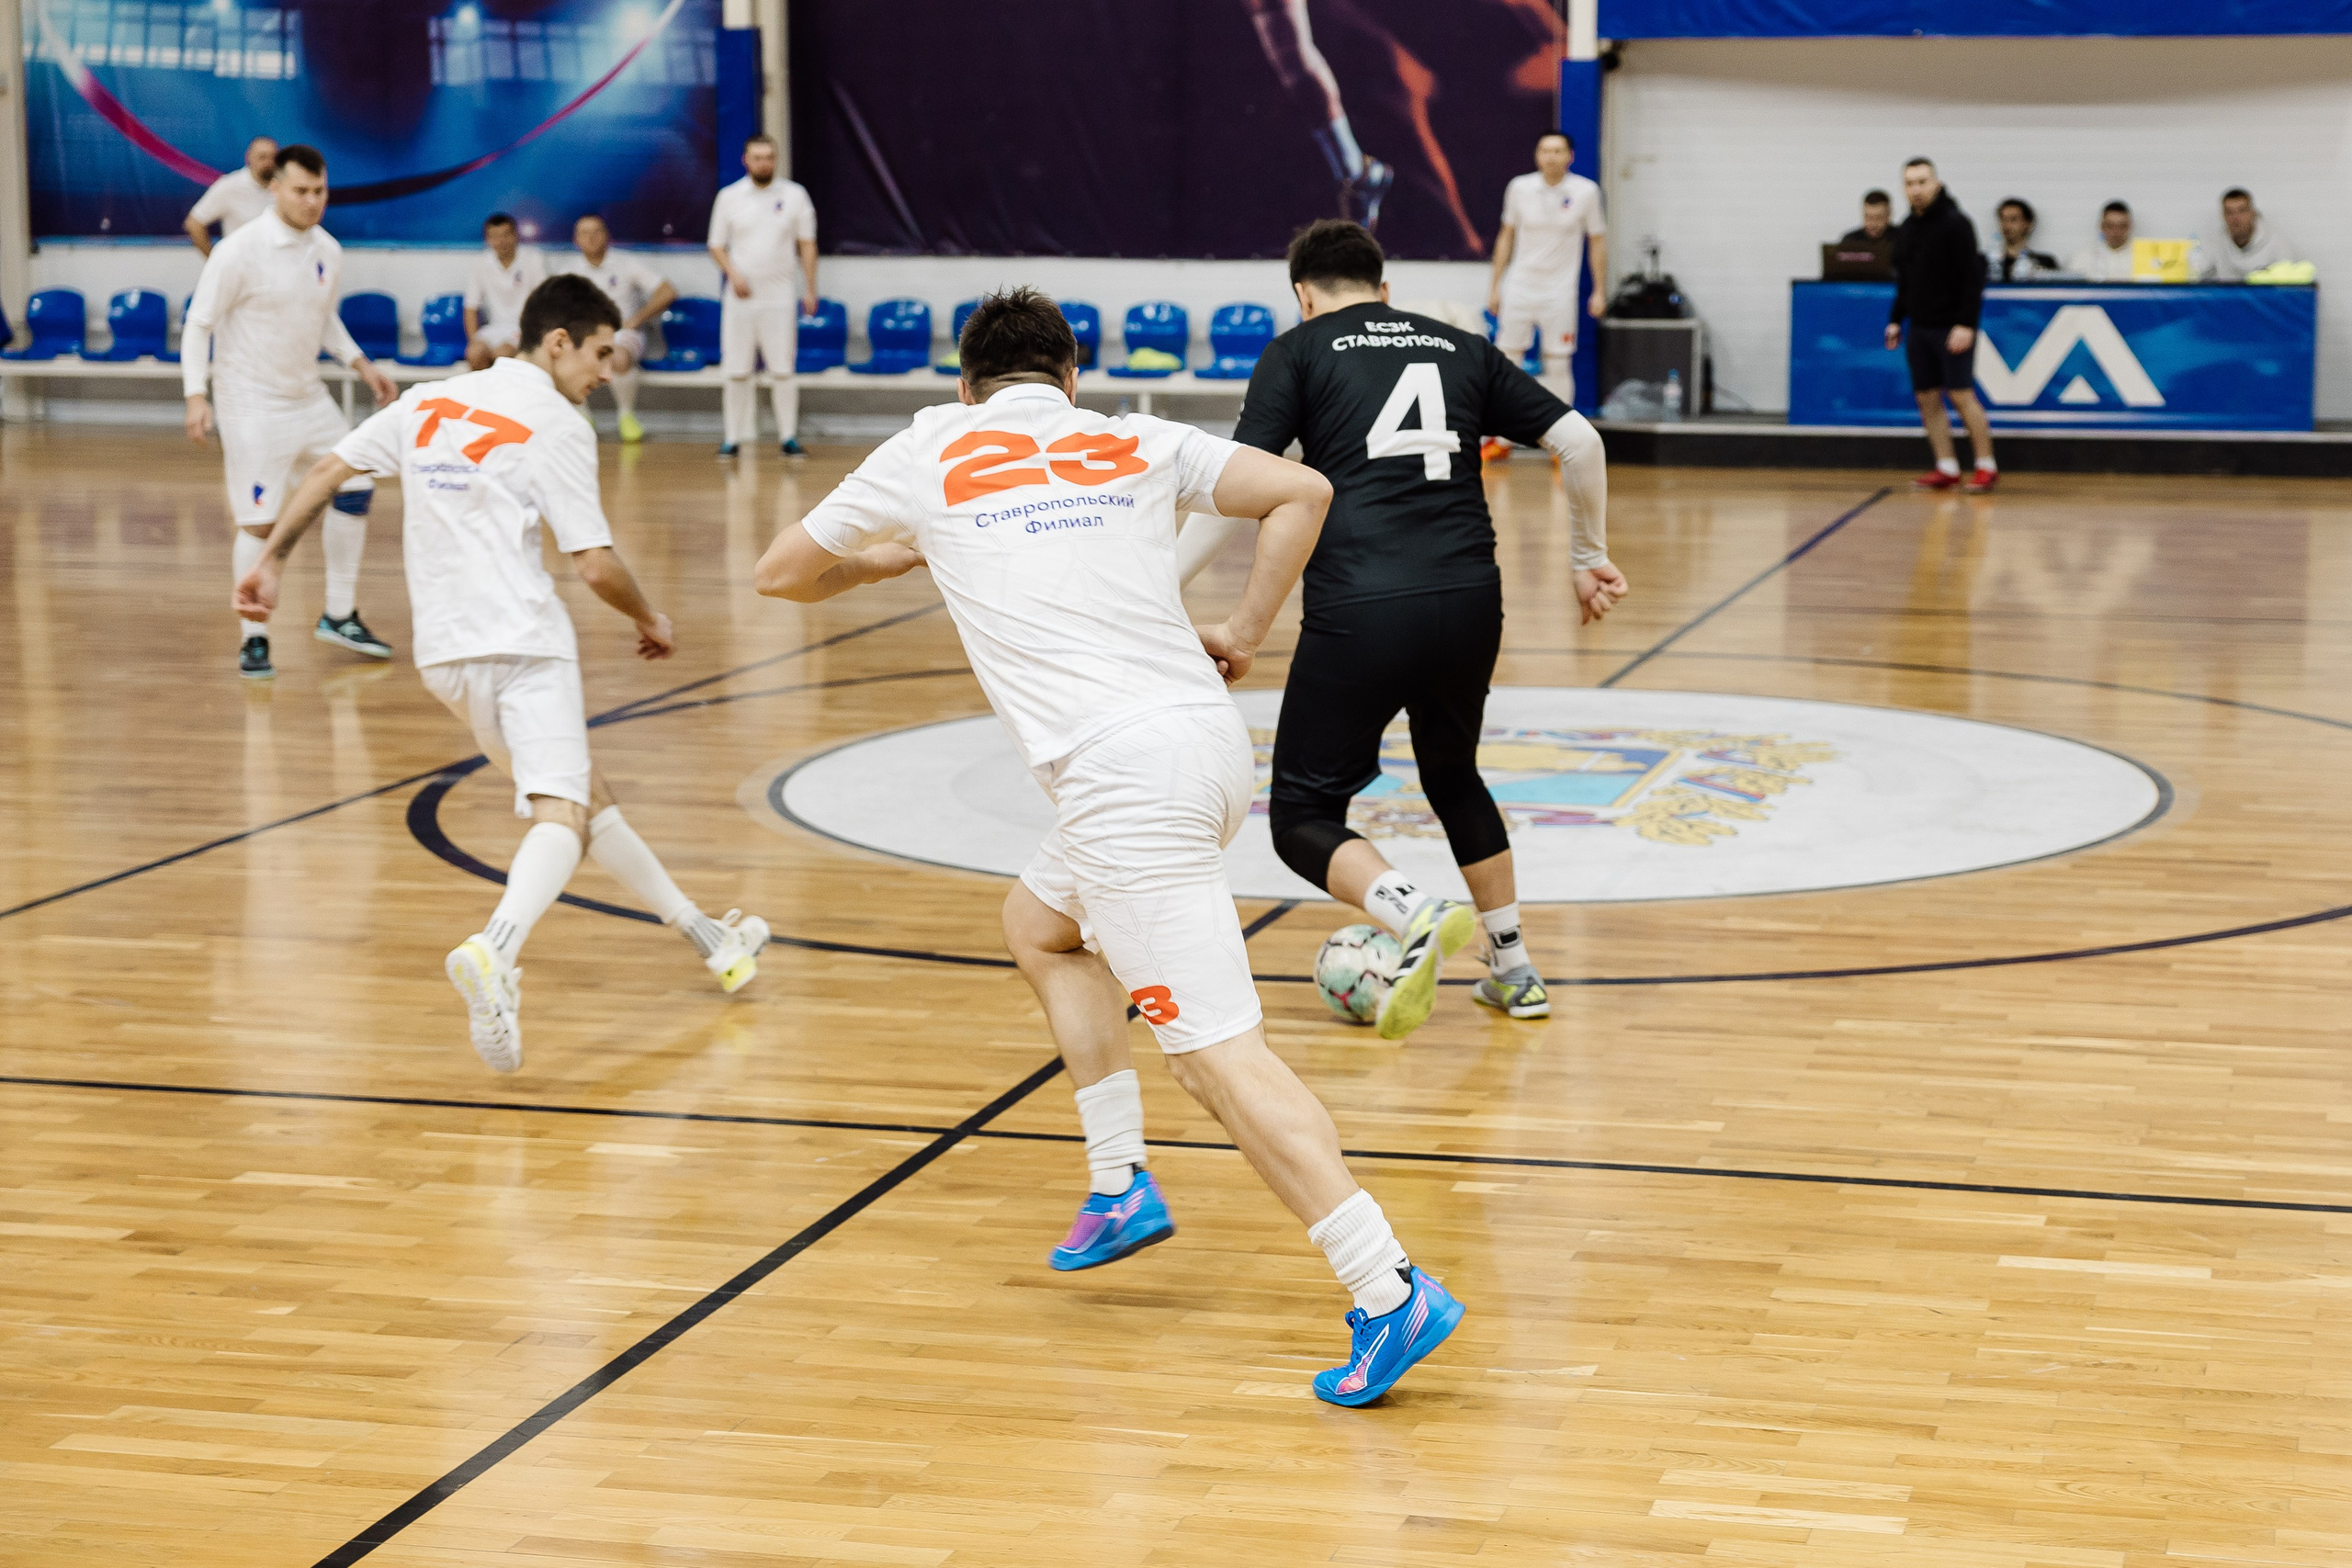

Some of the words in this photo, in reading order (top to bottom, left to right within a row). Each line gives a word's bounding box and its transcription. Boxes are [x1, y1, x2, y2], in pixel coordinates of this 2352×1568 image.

[1331, 334, 1456, 353] СТАВРОПОЛЬ
[1365, 362, 1461, 480] 4
[939, 430, 1149, 507] 23
[975, 493, 1136, 529] Ставропольский
[1024, 514, 1104, 534] Филиал
